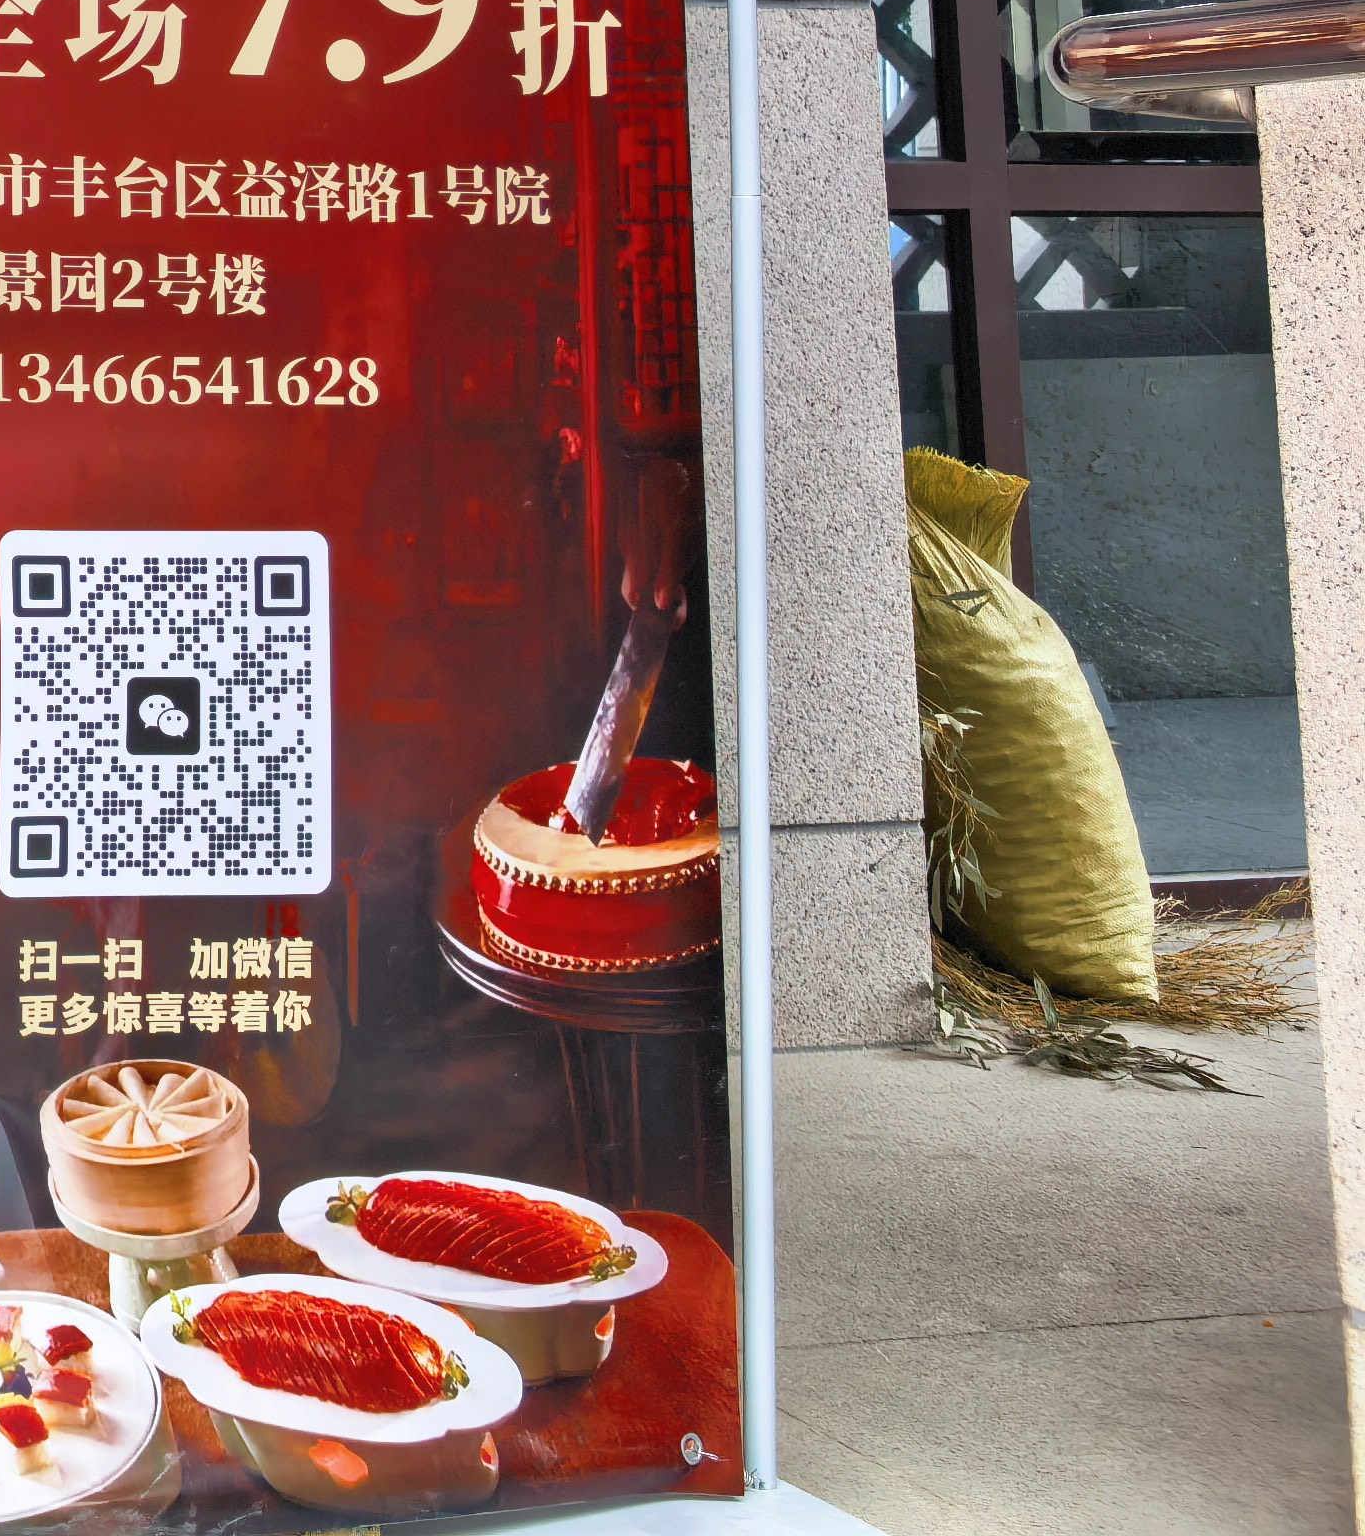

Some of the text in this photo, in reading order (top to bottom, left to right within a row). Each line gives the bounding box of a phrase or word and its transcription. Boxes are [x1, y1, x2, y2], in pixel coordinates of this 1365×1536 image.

[19, 937, 313, 982] 扫一扫 加微信
[19, 990, 312, 1037] 更多惊喜等着你
